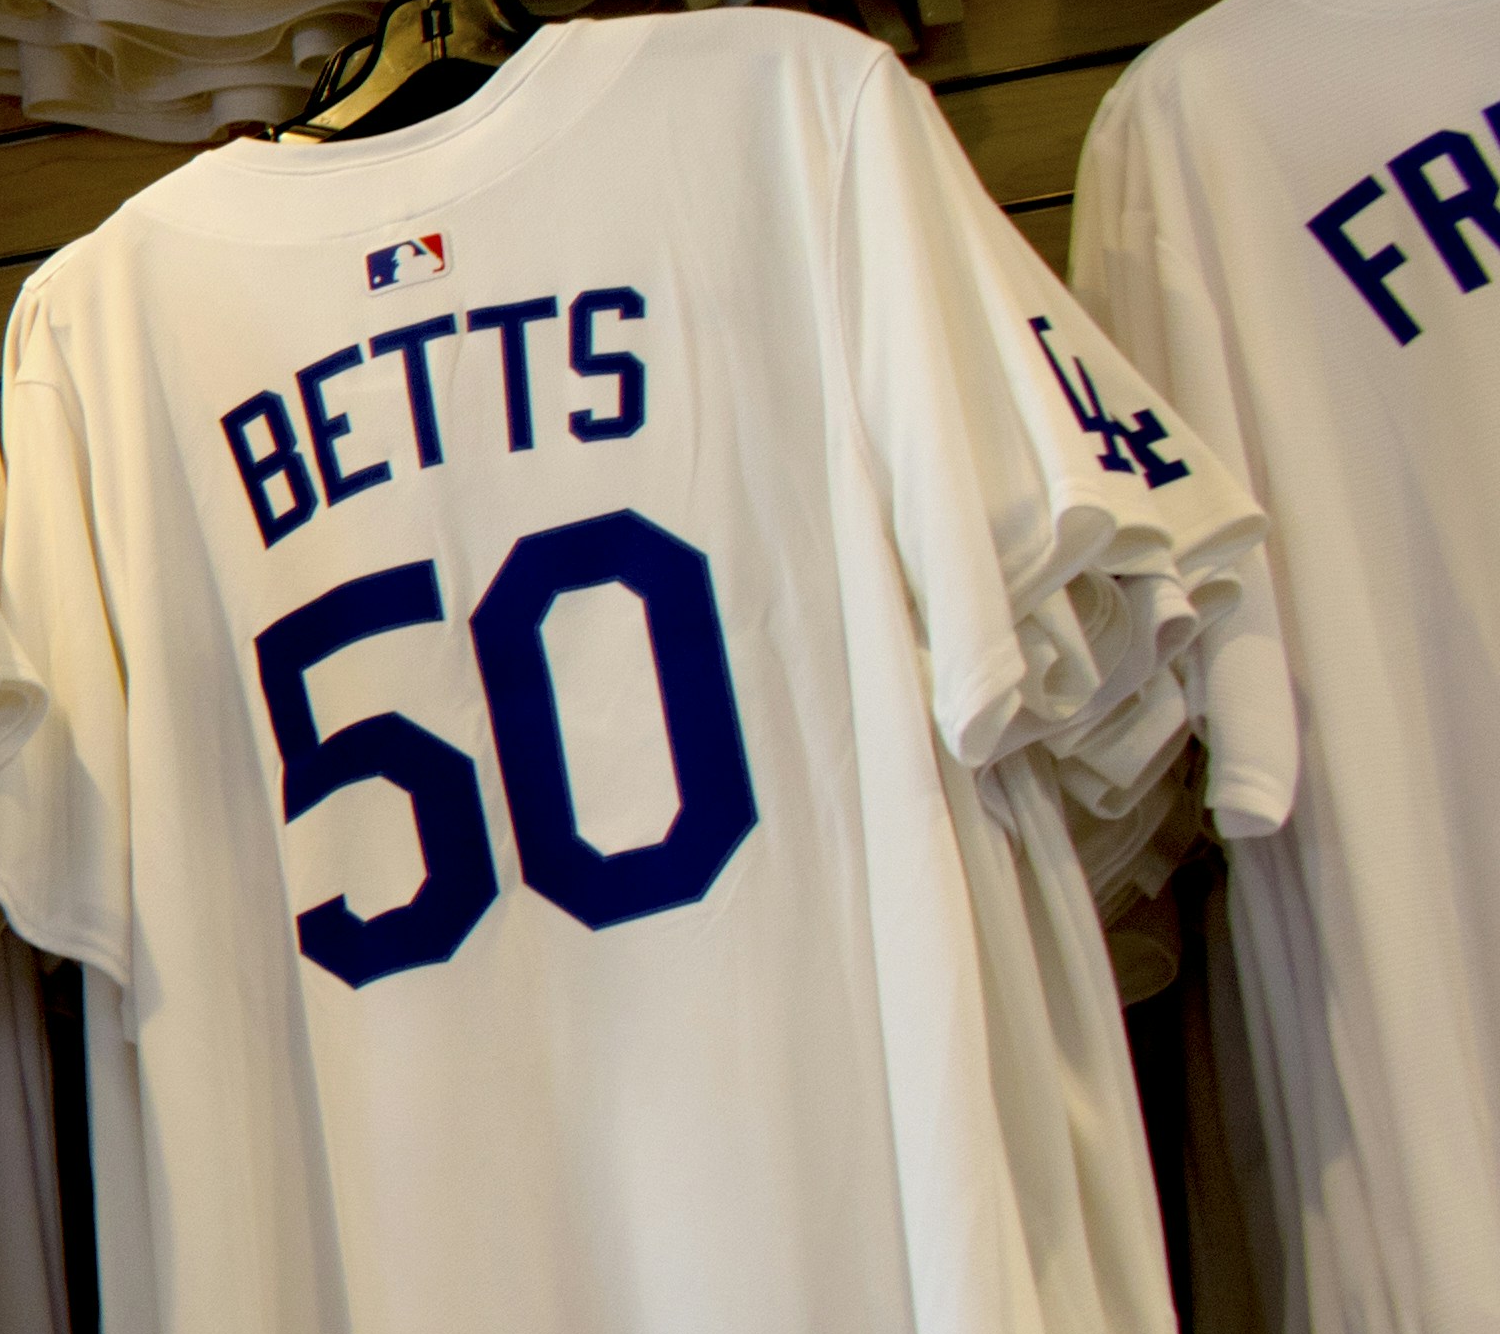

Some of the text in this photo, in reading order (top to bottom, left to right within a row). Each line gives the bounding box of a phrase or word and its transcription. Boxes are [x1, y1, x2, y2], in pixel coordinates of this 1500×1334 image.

[1305, 99, 1500, 348] FR
[220, 286, 646, 548] BETTS
[253, 508, 760, 991] 50
